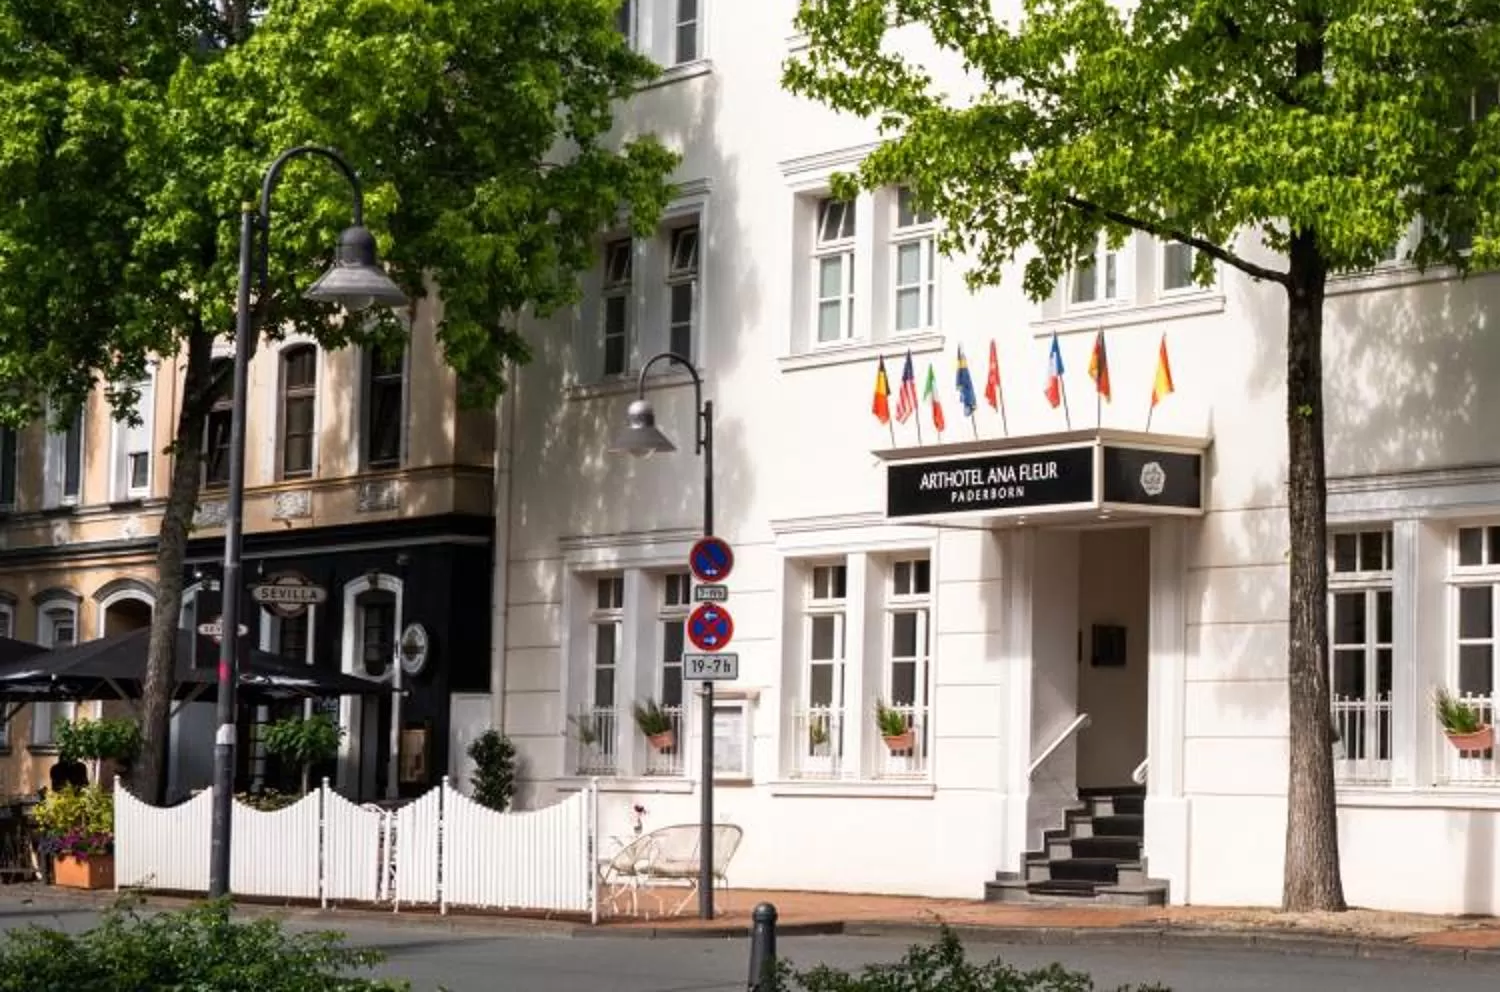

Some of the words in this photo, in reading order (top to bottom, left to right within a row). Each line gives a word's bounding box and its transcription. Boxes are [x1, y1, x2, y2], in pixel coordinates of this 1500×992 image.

[920, 469, 984, 489] ARTHOTEL
[987, 465, 1017, 484] ANA
[1019, 461, 1059, 481] FLEUR
[951, 486, 1025, 503] PADERBORN
[261, 588, 317, 600] SEVILLA
